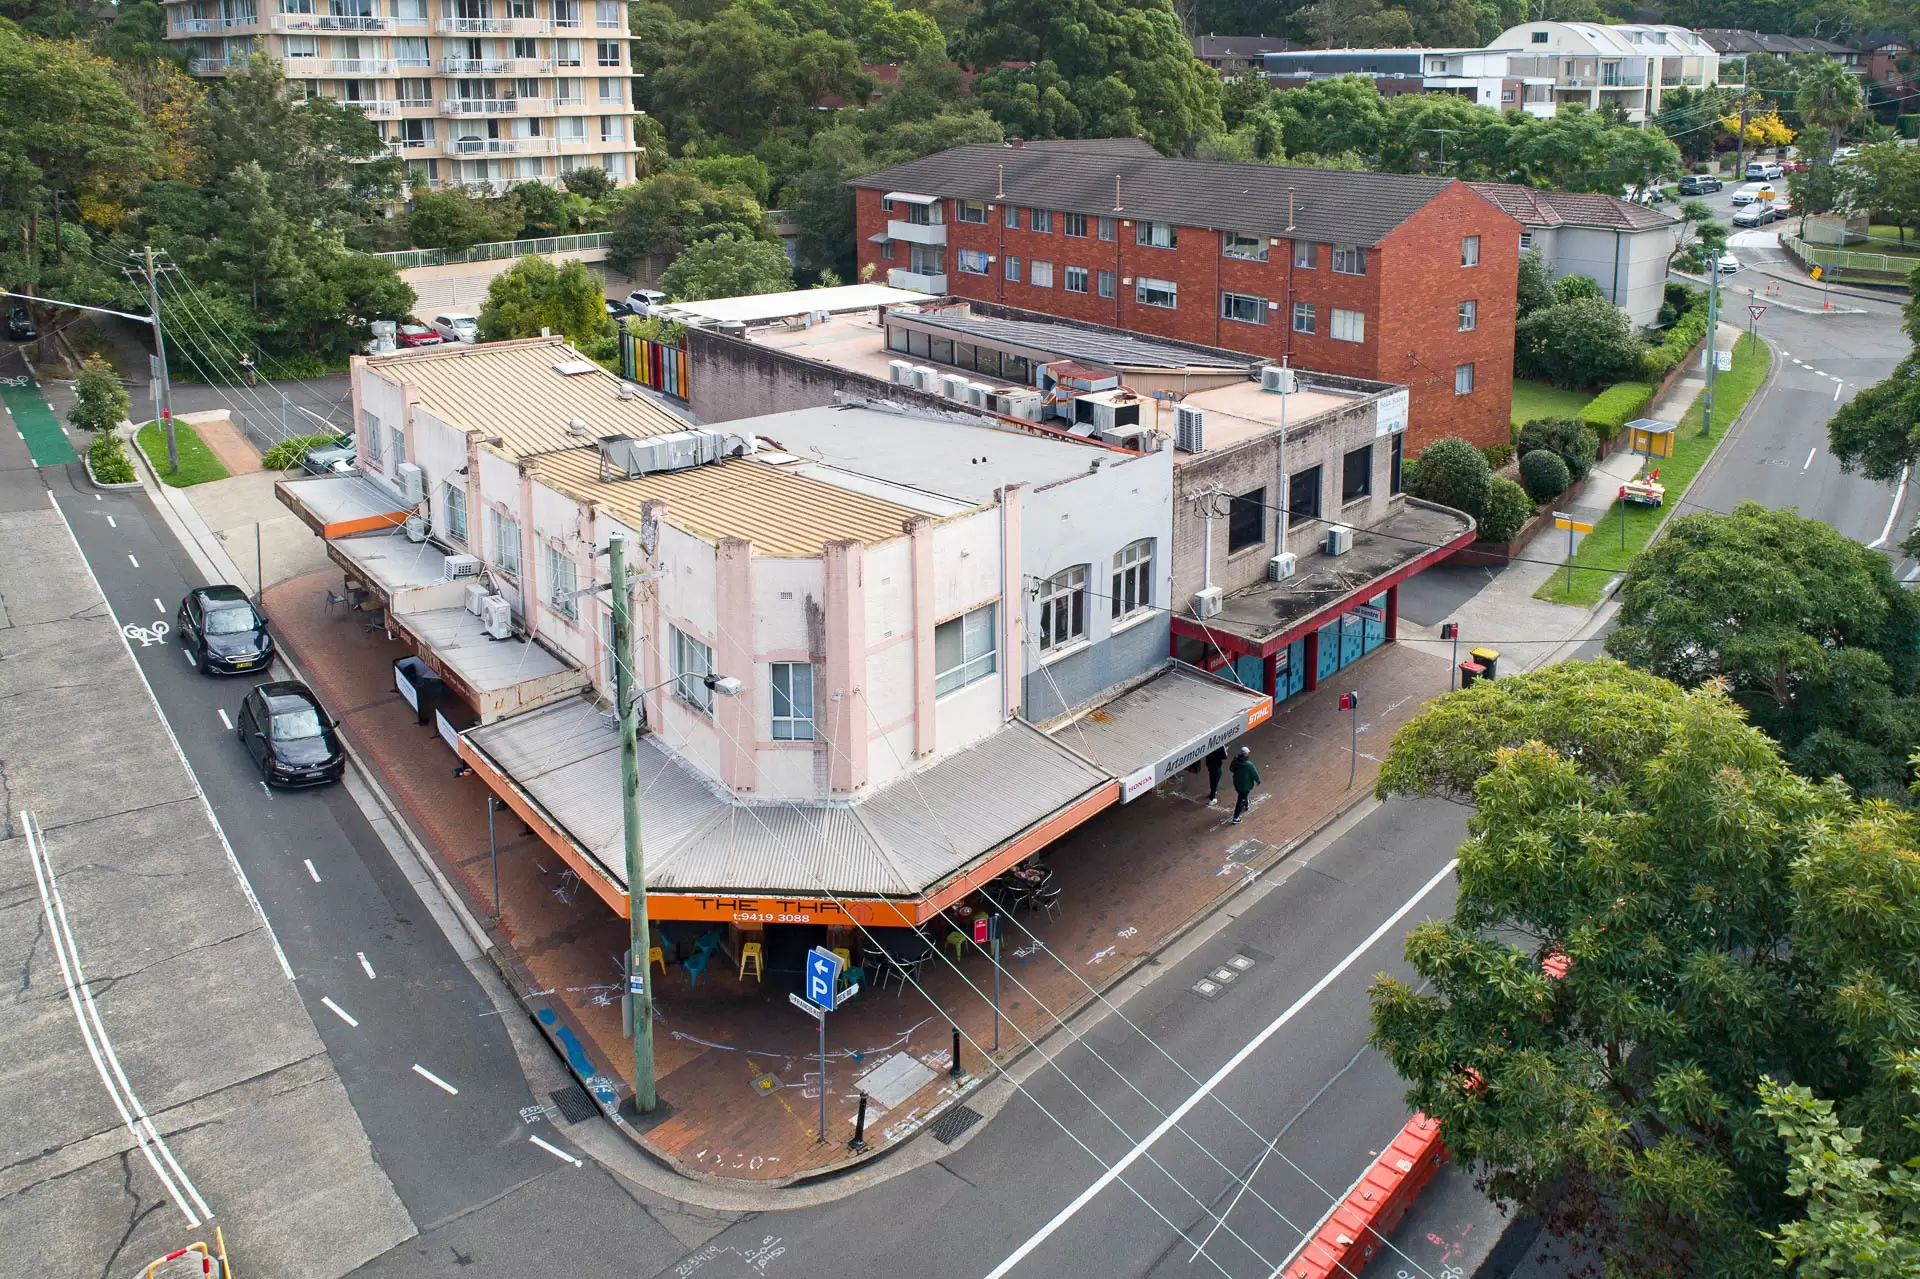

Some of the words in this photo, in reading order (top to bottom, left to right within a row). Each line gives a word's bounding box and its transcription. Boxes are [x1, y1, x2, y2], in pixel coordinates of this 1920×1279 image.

[1248, 706, 1269, 725] STIHL
[1164, 744, 1206, 775] Artarmon
[1207, 724, 1240, 751] Mowers
[1128, 775, 1153, 793] HONDA
[695, 898, 759, 911] THE
[733, 912, 773, 921] t:9419
[778, 913, 810, 923] 3088
[812, 976, 828, 999] P
